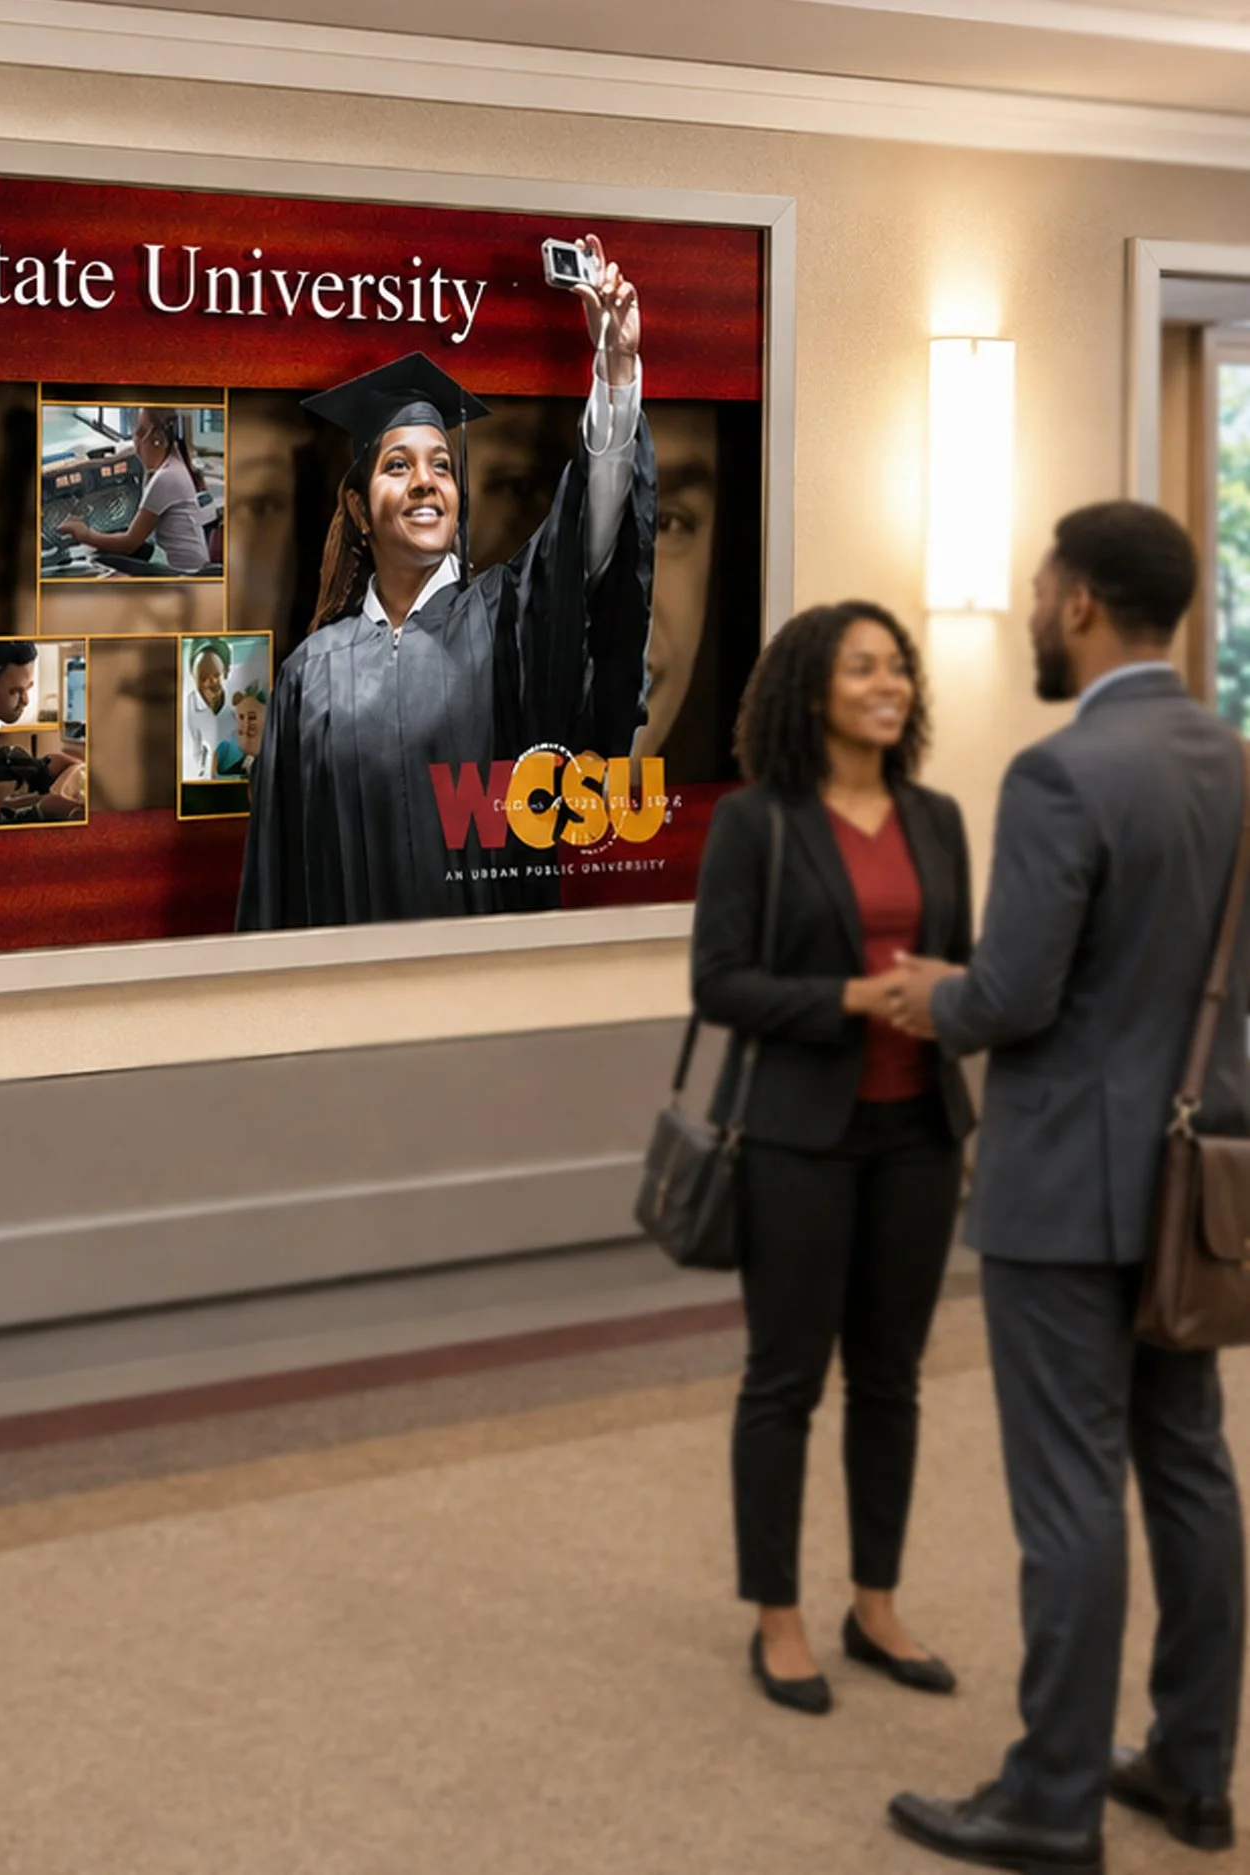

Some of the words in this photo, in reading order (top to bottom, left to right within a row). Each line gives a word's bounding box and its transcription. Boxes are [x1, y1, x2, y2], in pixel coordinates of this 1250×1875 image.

[143, 243, 487, 343] University
[445, 871, 463, 881] AN
[526, 863, 575, 876] PUBLIC
[581, 859, 665, 874] UNIVERSITY
